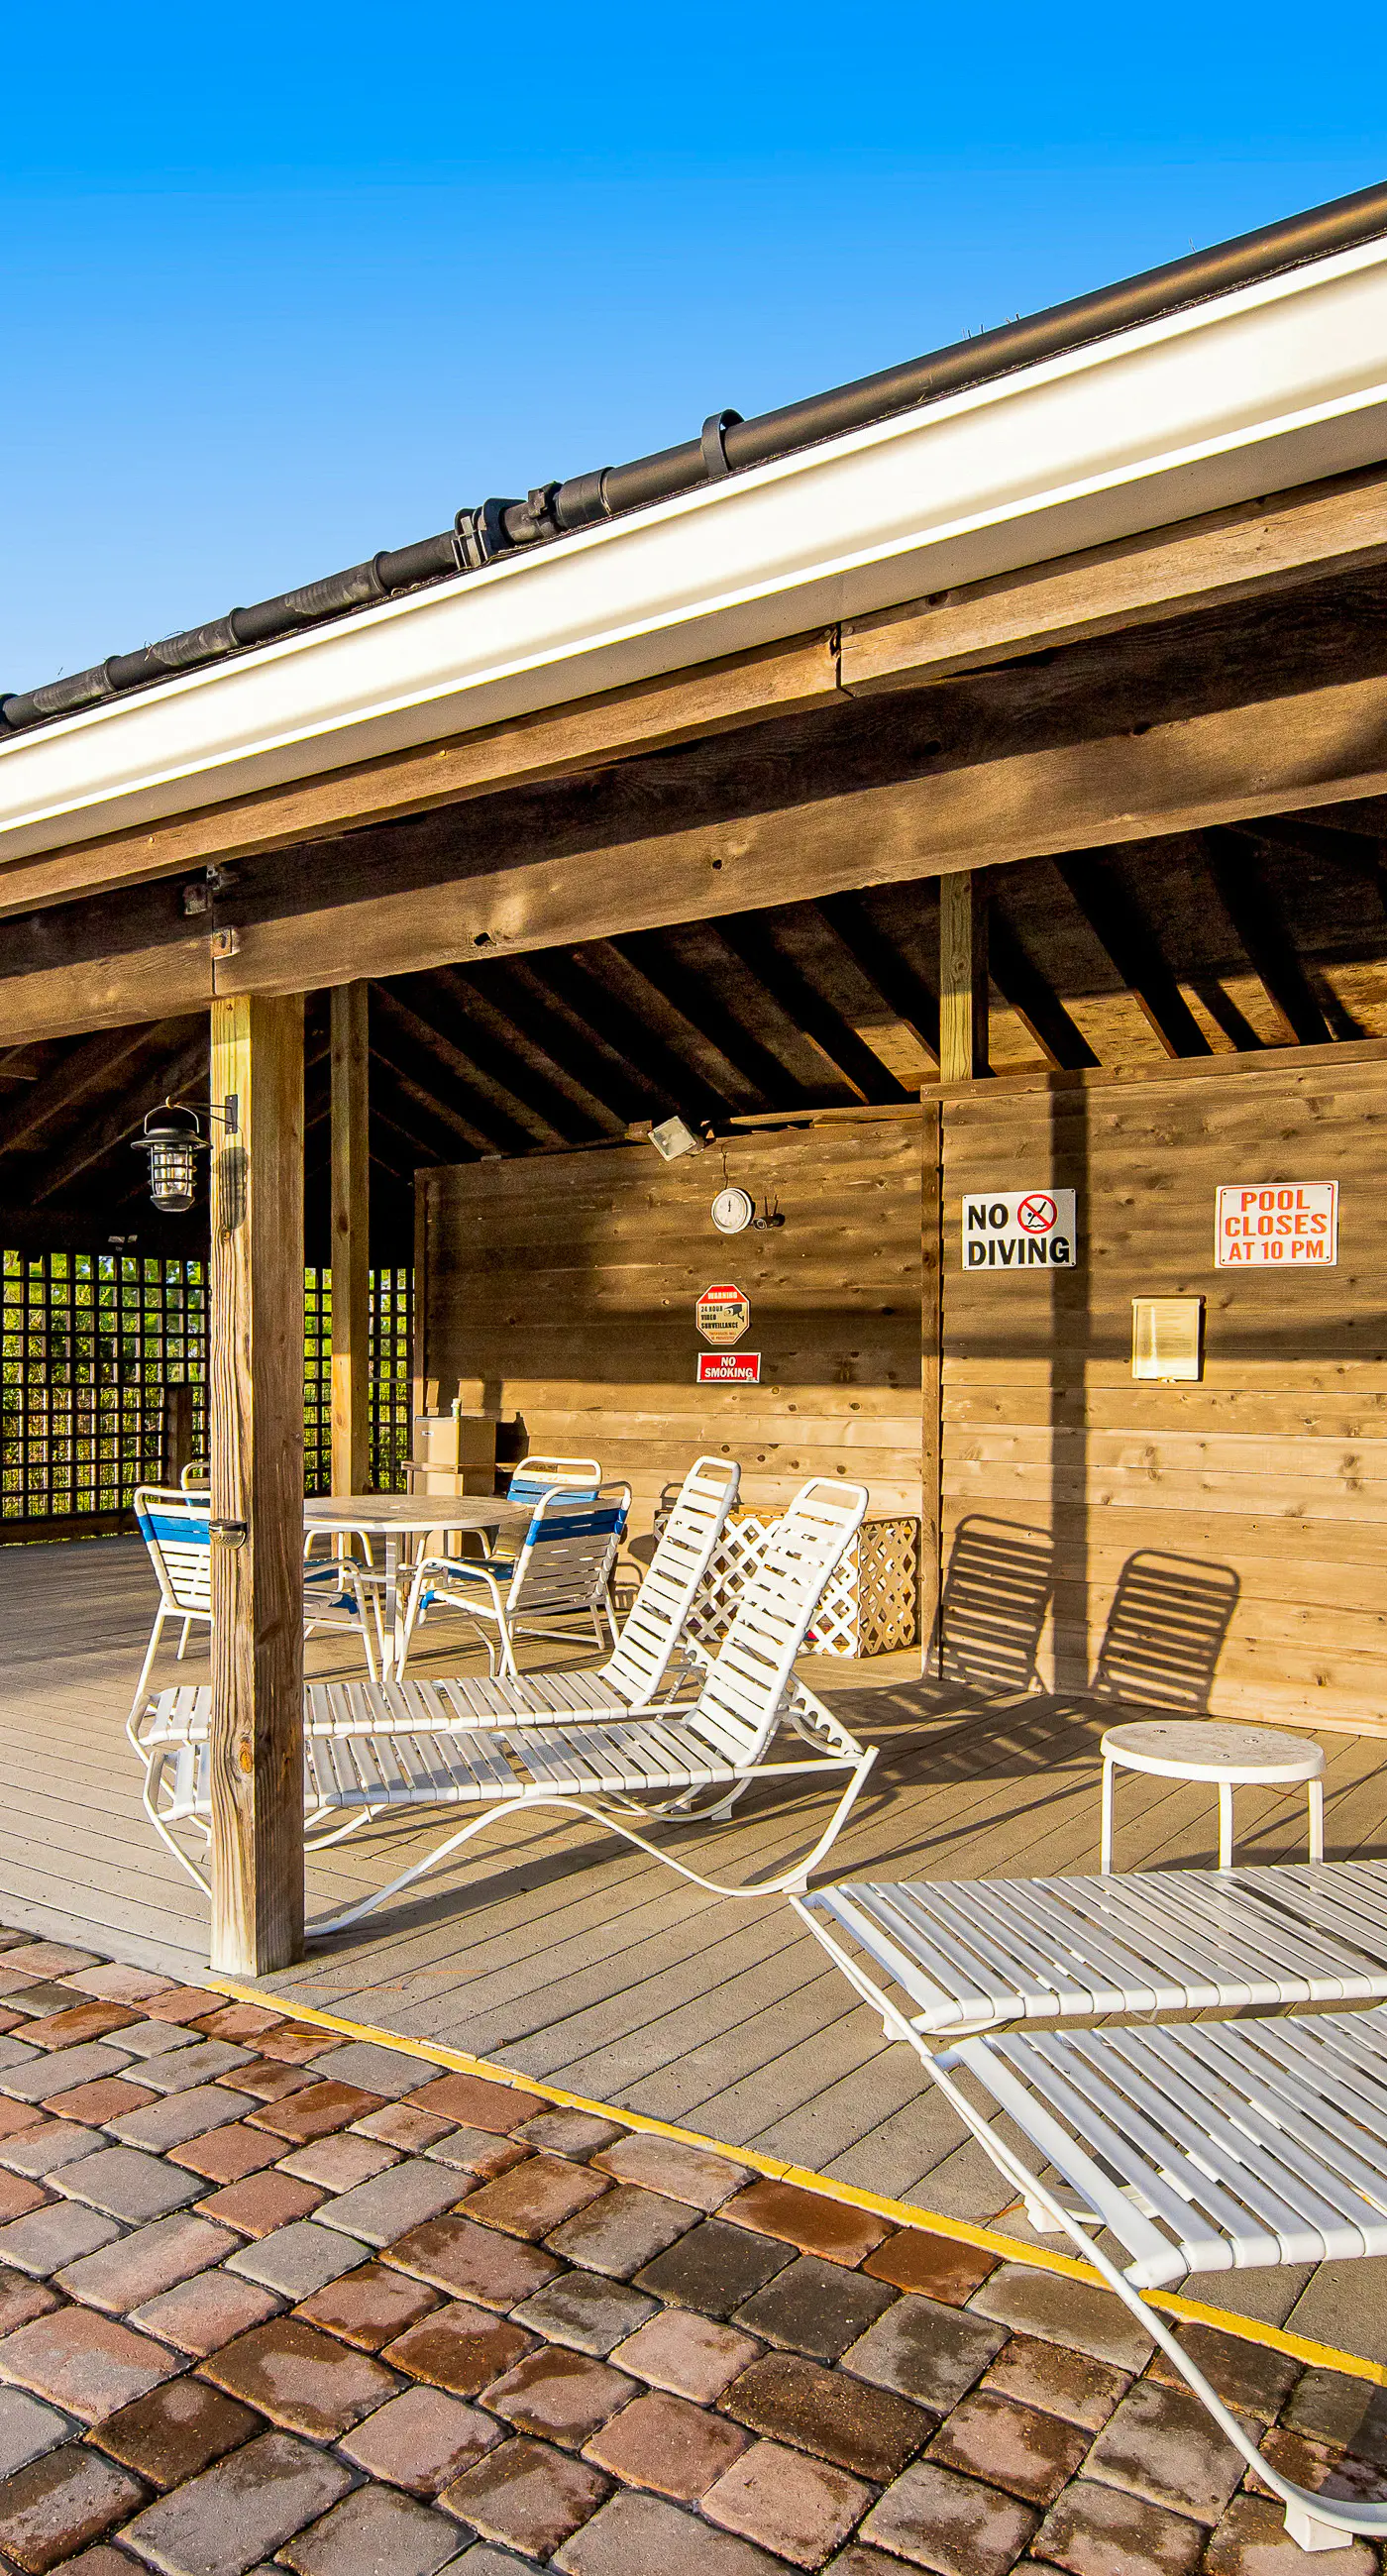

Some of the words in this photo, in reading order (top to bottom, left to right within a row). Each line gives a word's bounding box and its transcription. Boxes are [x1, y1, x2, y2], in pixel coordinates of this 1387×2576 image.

[1241, 1189, 1311, 1212] POOL
[968, 1203, 1009, 1230] NO
[1225, 1214, 1328, 1236] CLOSES
[968, 1236, 1070, 1266] DIVING
[1228, 1241, 1255, 1260] AT
[1261, 1240, 1284, 1259] 10
[1291, 1240, 1324, 1259] PM
[704, 1367, 753, 1378] SMOKING
[720, 1356, 736, 1367] NO
